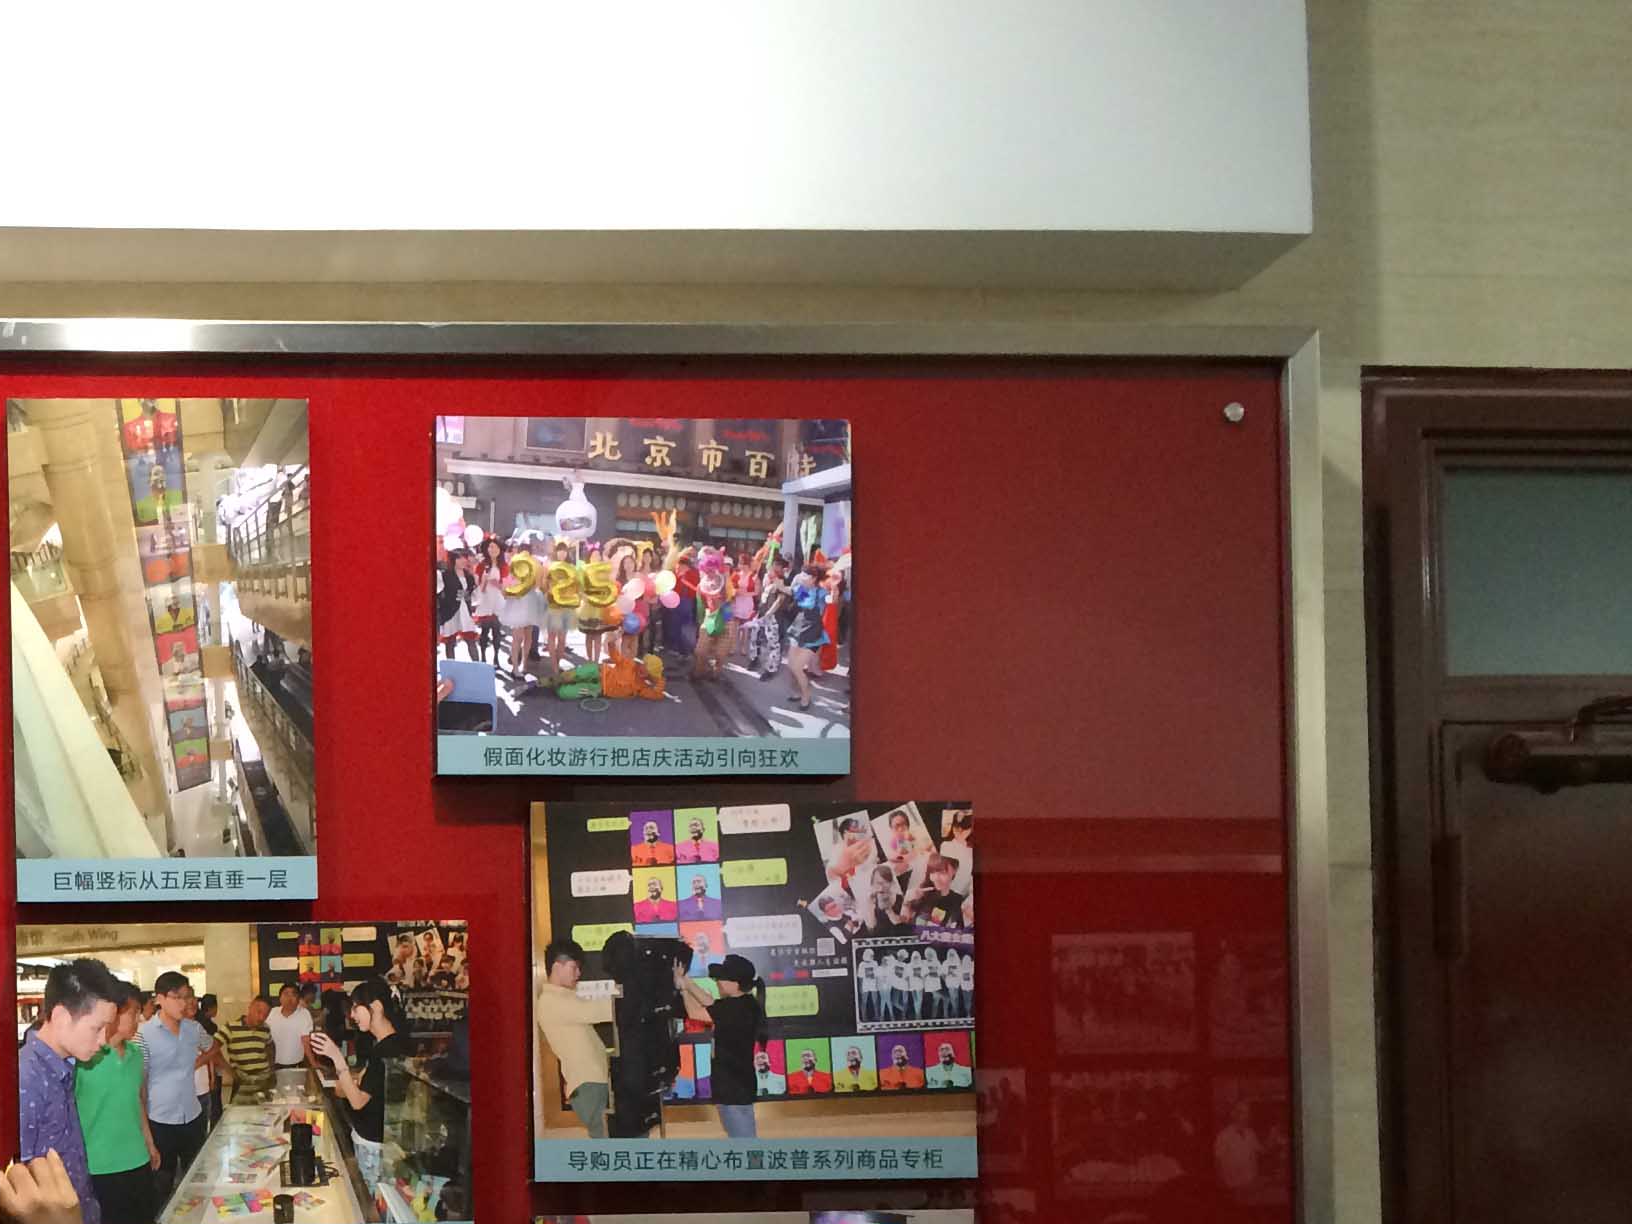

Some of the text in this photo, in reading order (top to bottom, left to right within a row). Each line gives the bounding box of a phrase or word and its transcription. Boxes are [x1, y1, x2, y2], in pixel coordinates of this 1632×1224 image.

[483, 746, 799, 769] 假面化妆游行把店庆活动引向狂欢
[53, 869, 288, 891] 巨幅竖标从五层直垂一层
[567, 1147, 943, 1172] 导购员正在精心布置波普系列商品专柜
